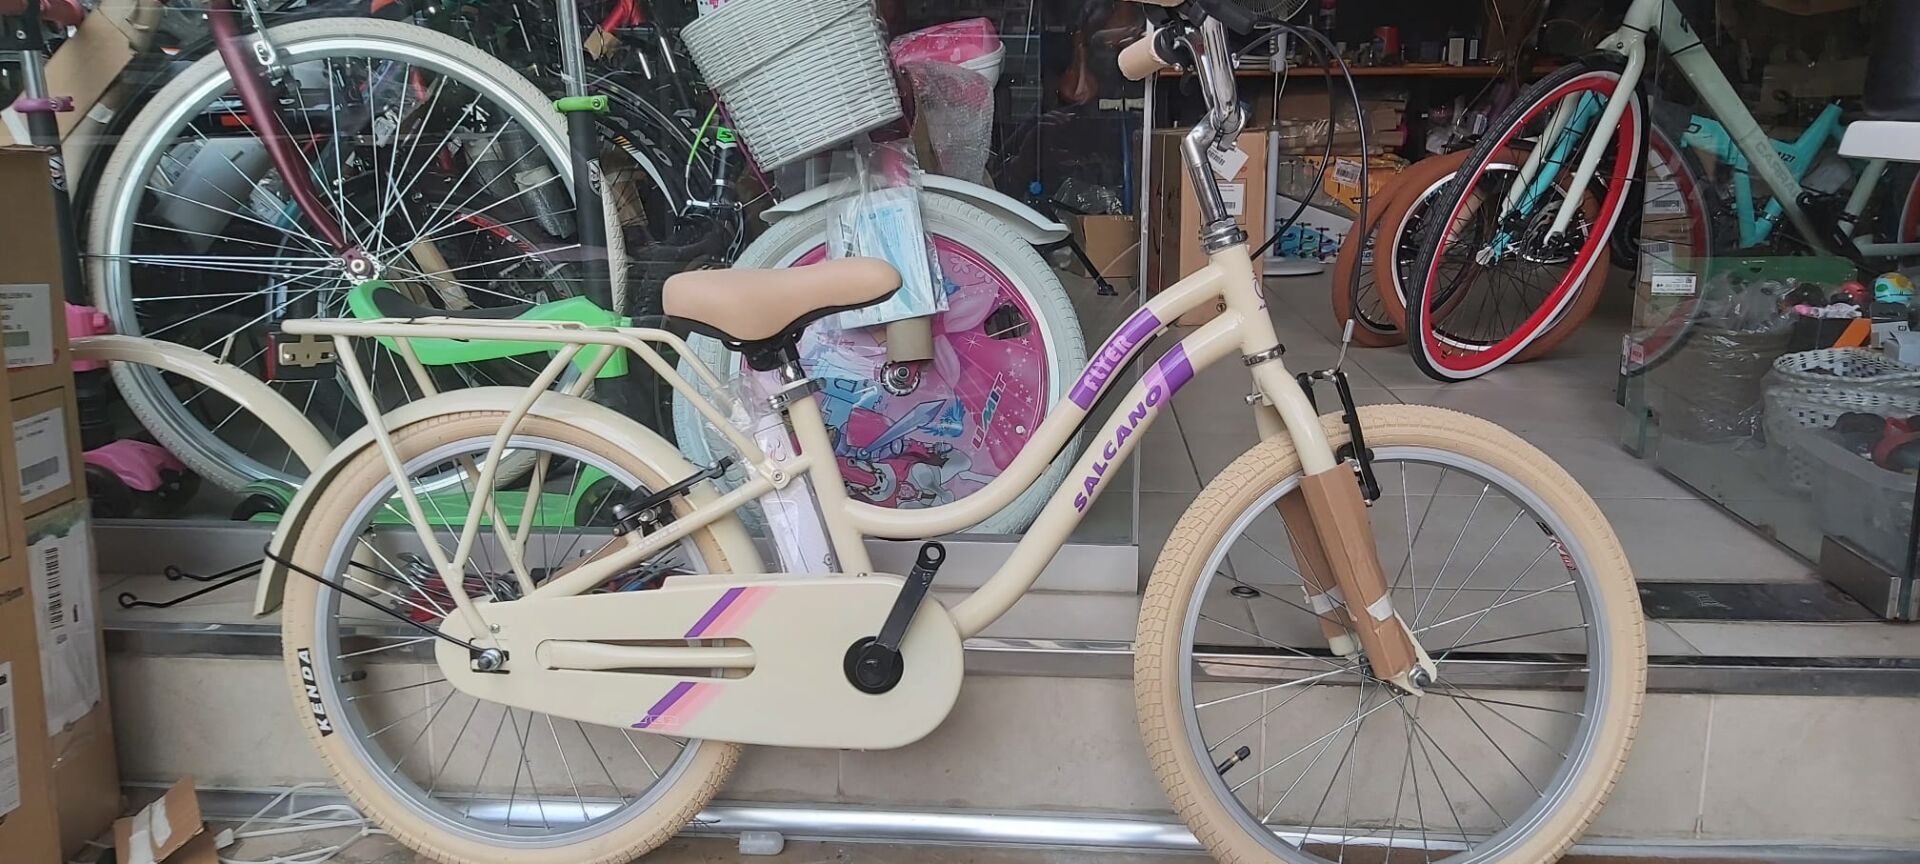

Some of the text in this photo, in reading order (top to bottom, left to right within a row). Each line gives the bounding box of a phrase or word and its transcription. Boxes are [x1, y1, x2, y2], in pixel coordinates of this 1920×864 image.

[1083, 335, 1134, 392] FLYER
[1073, 384, 1162, 513] SALCANO
[298, 650, 333, 732] KENDA
